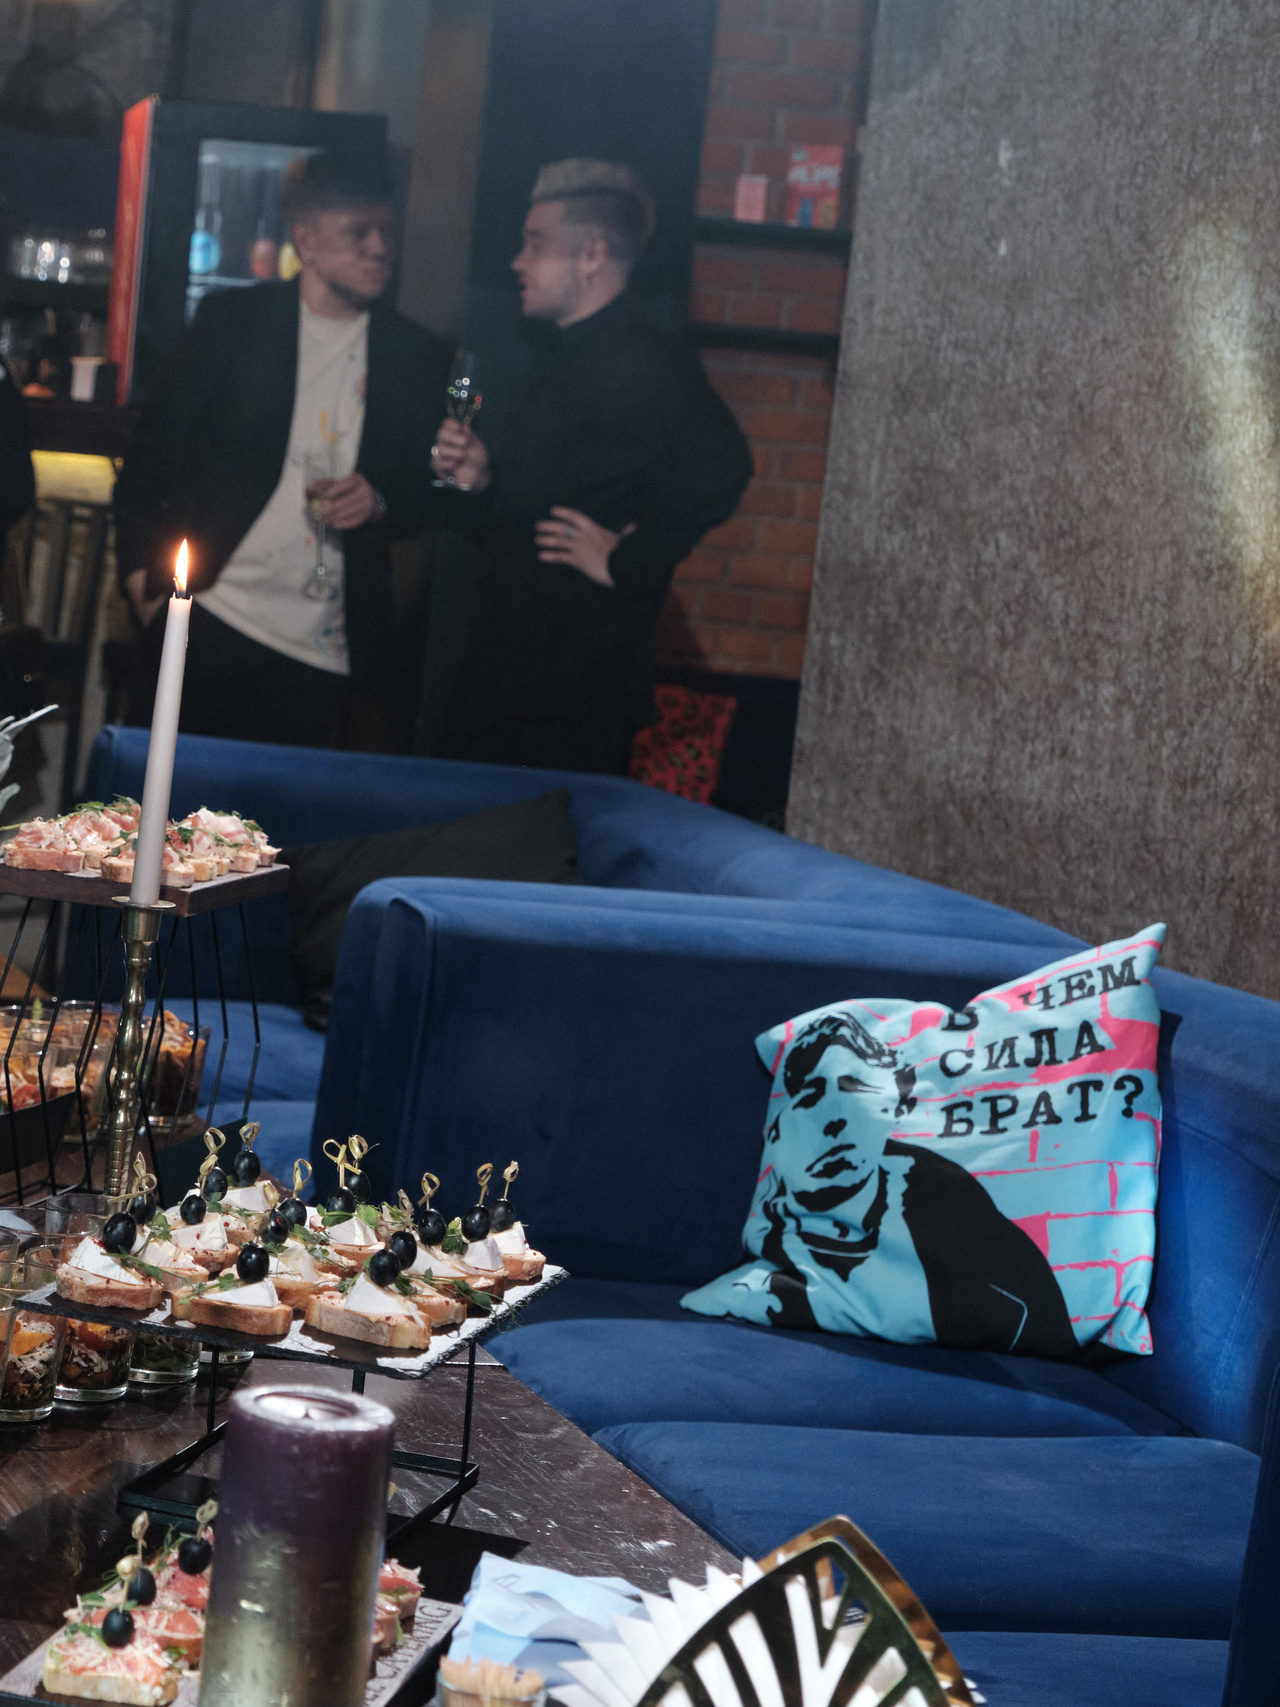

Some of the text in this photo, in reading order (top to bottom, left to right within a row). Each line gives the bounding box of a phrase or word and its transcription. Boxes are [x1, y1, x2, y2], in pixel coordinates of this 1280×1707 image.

[1019, 956, 1141, 1011] ЧЕМ
[939, 1020, 1106, 1079] СИЛА
[937, 1075, 1144, 1139] БРАТ?
